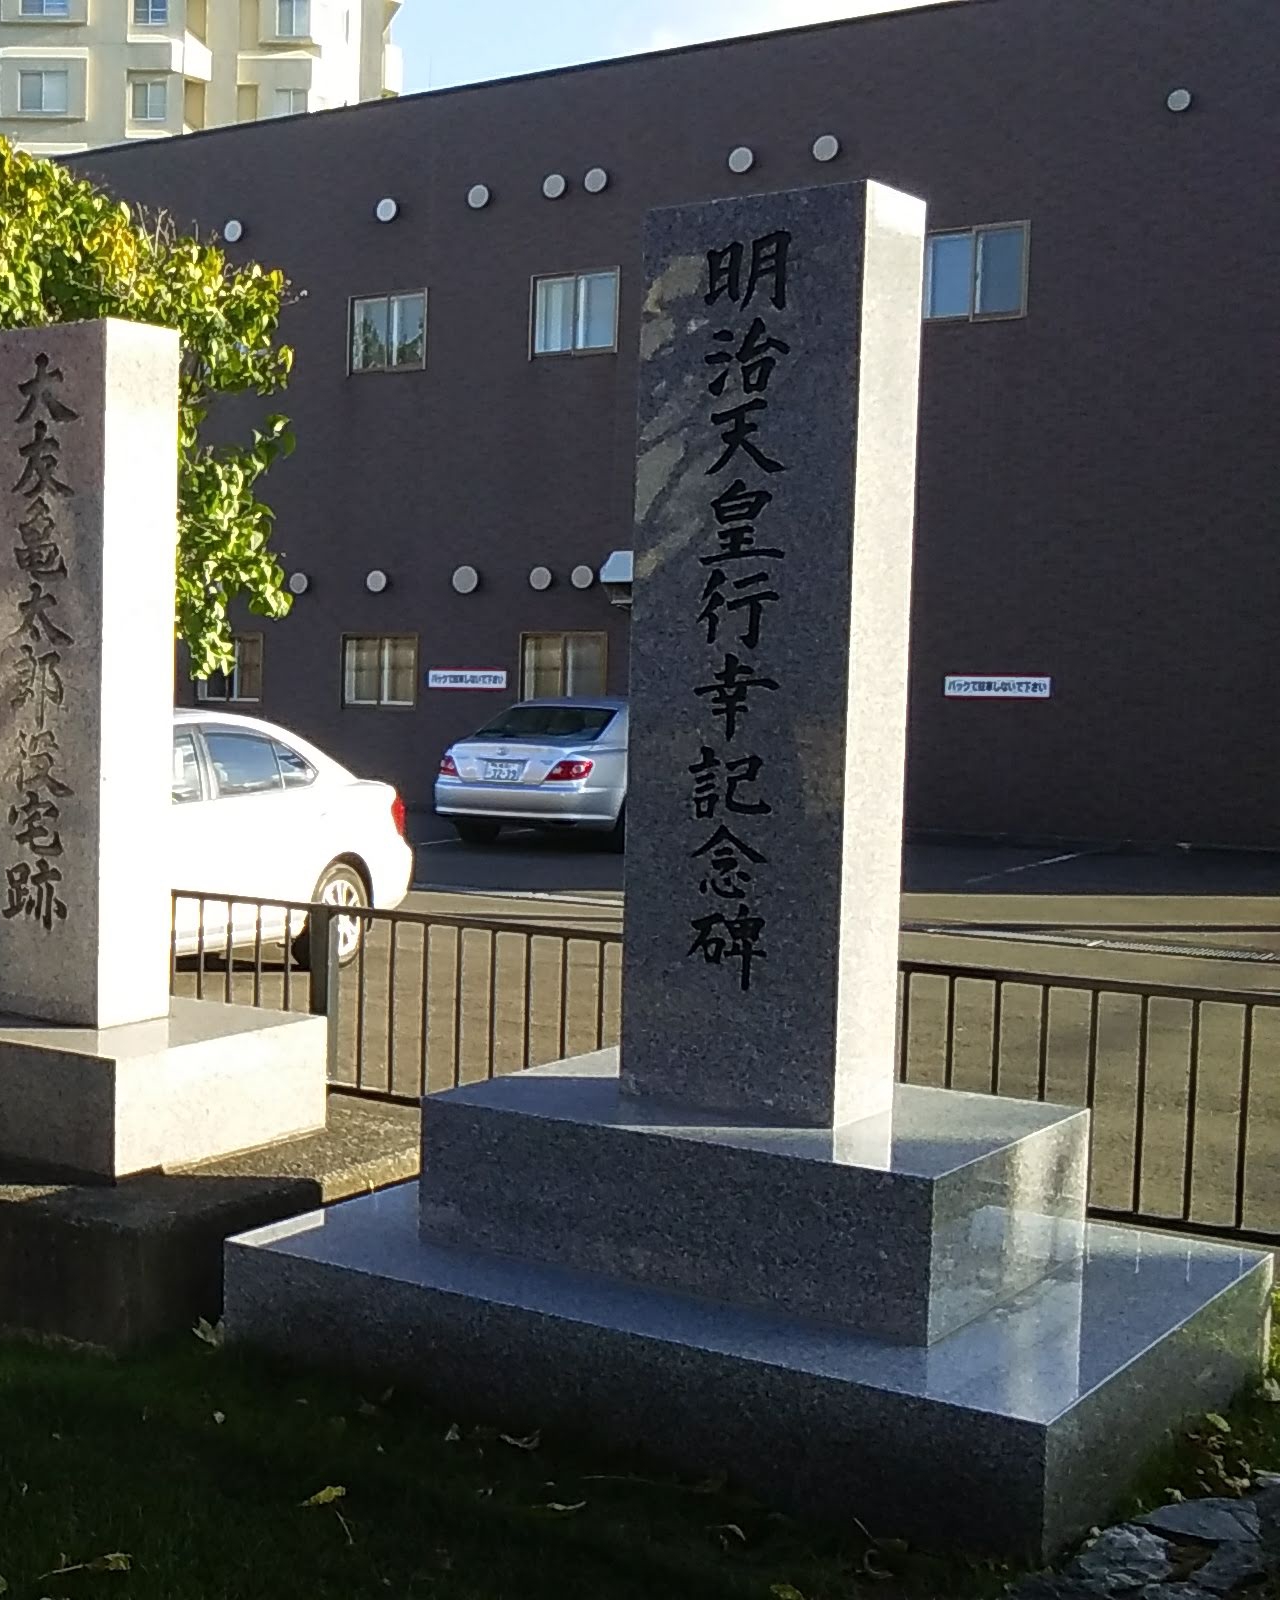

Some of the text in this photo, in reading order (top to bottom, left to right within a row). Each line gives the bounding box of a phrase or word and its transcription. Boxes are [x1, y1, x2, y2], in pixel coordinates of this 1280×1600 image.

[3, 351, 80, 931] 大友亀太郎役宅跡
[687, 229, 793, 992] 明治天皇行幸記念碑
